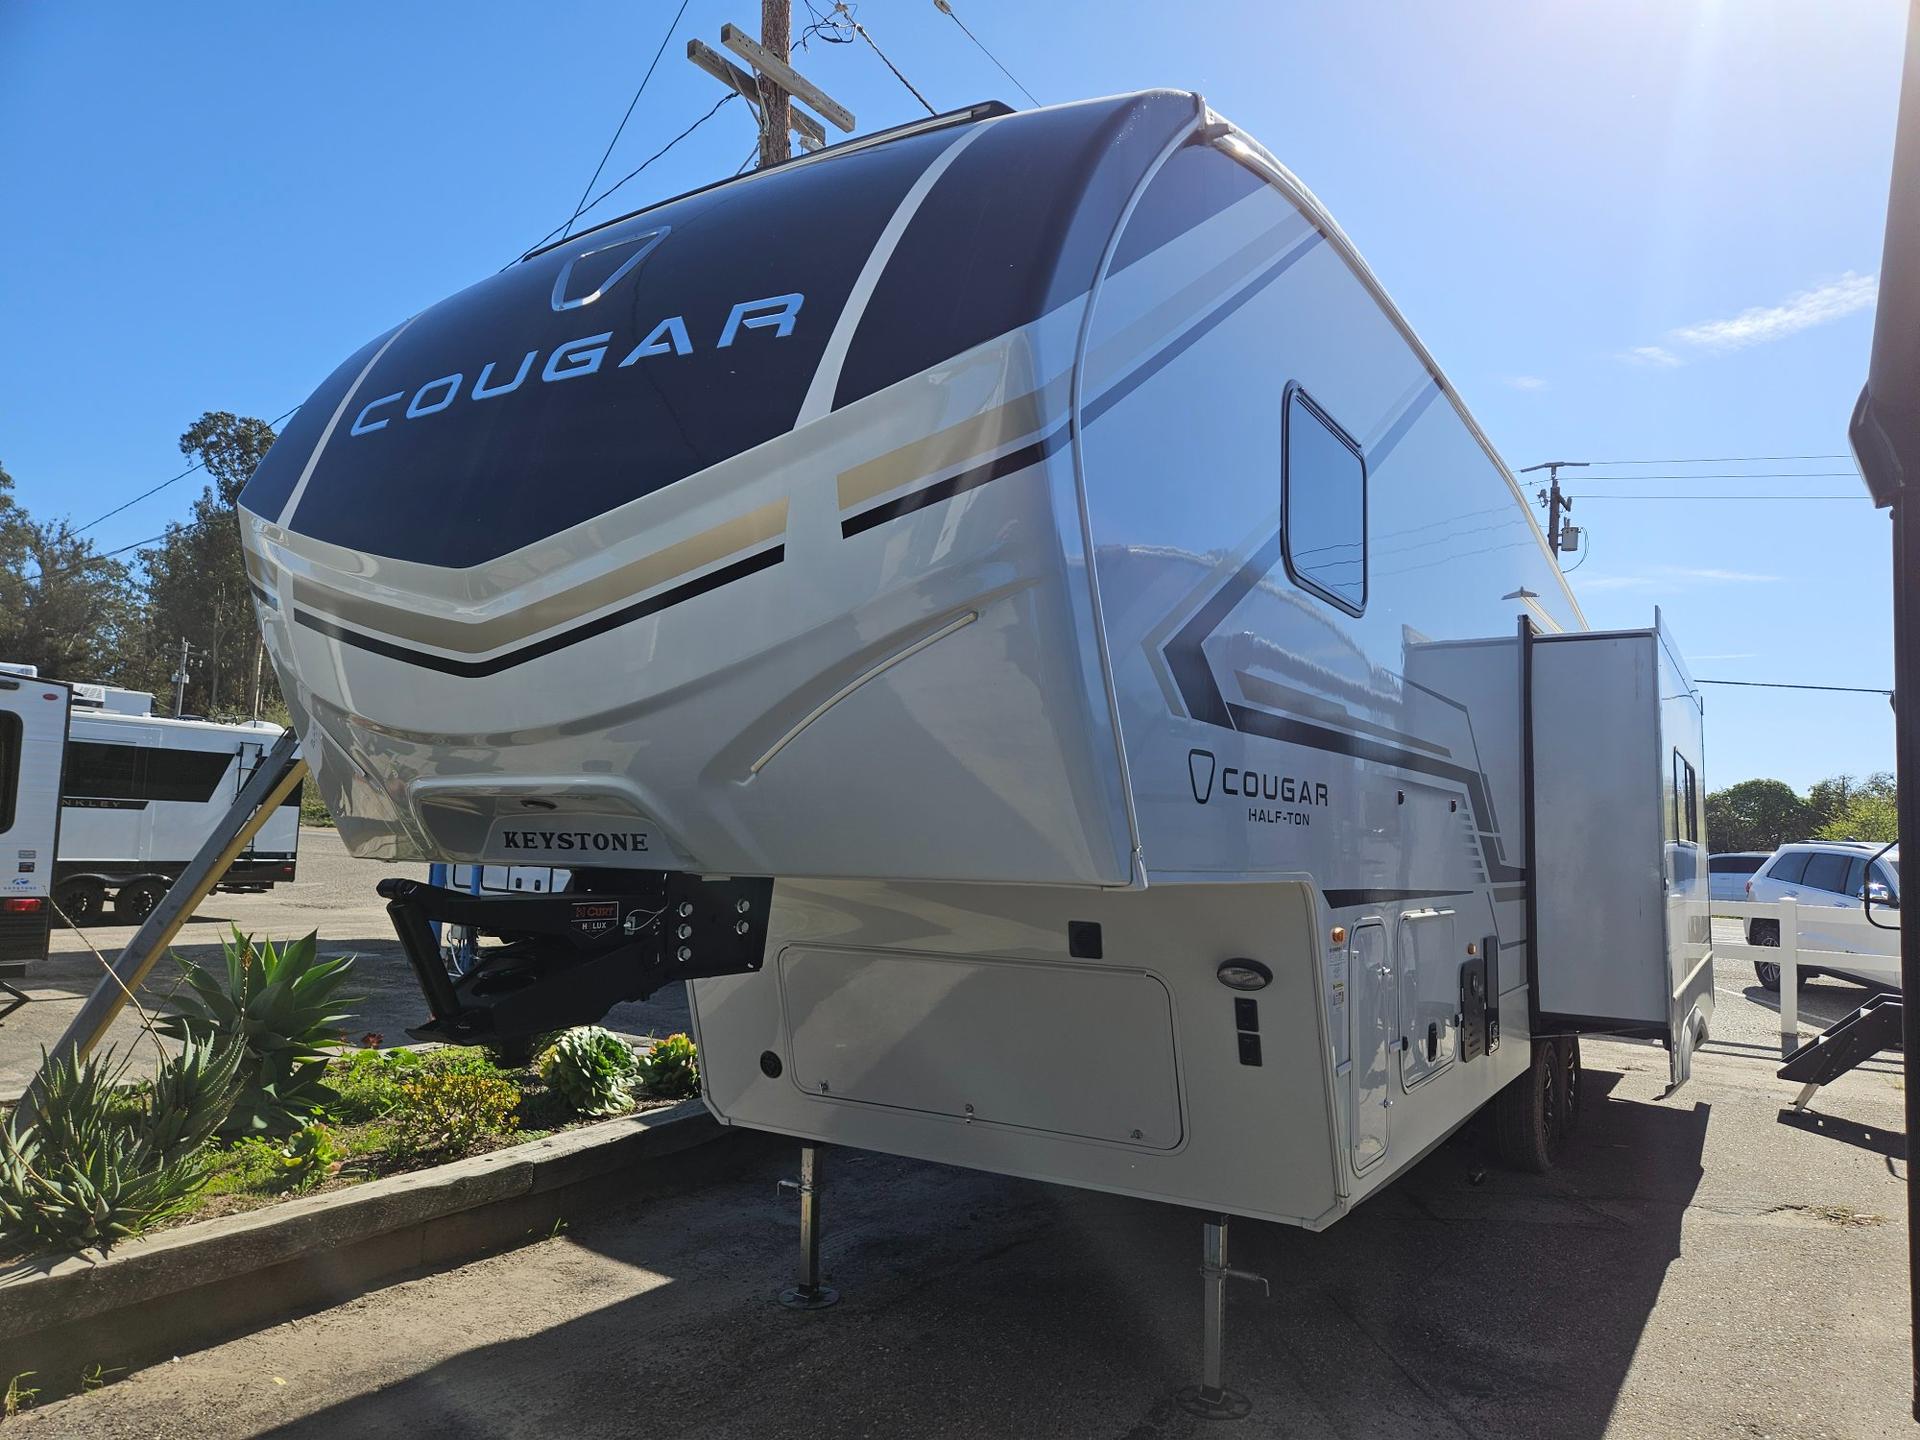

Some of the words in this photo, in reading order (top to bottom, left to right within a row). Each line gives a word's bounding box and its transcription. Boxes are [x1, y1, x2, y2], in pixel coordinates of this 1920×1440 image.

[350, 292, 804, 436] COUGAR
[1222, 767, 1328, 806] COUGAR
[1248, 808, 1310, 826] HALF-TON
[502, 831, 649, 852] KEYSTONE
[587, 905, 614, 918] CURT
